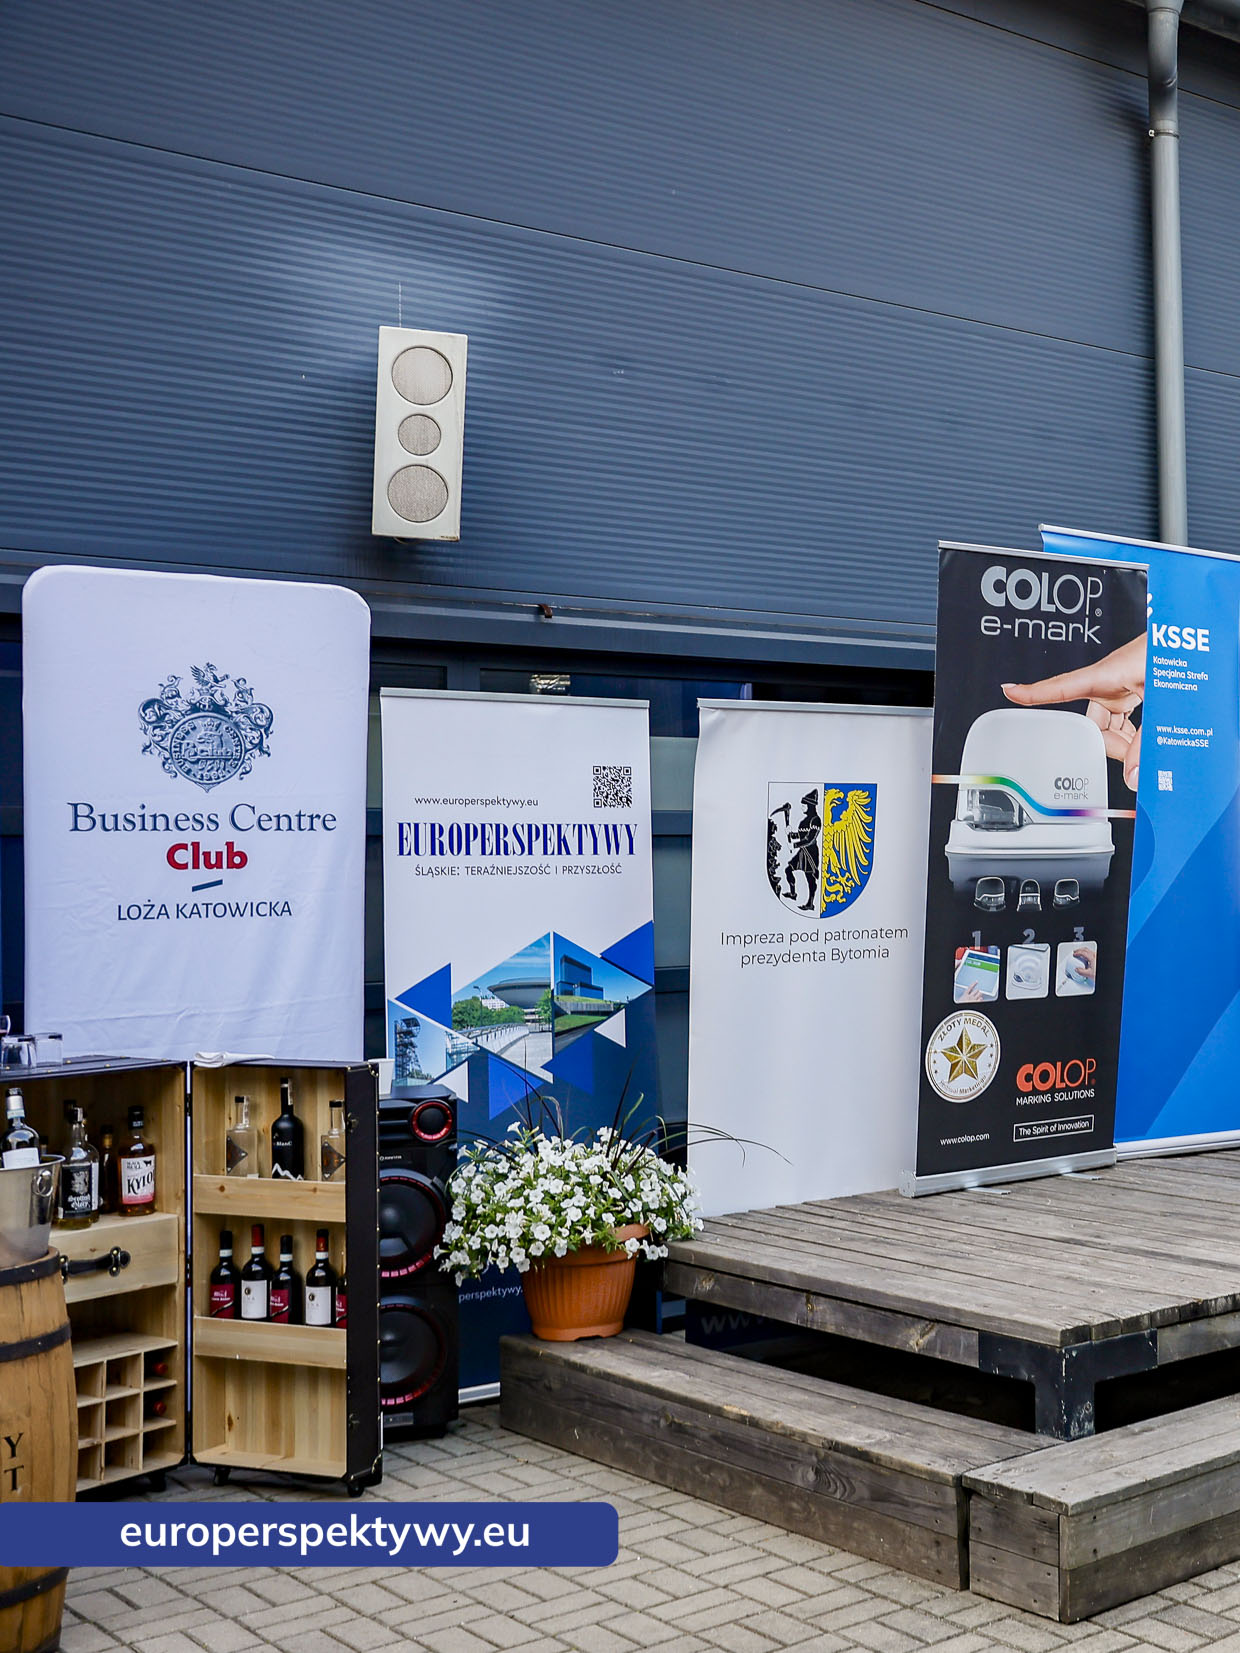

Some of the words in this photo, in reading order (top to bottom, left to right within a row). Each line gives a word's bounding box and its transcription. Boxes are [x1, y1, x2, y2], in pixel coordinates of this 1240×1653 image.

[981, 565, 1103, 615] COLOP
[981, 615, 1102, 645] e-mark
[1152, 624, 1210, 652] KSSE
[1153, 656, 1188, 668] Katowicka
[1153, 668, 1185, 681] Specjalna
[1186, 670, 1209, 680] Strefa
[1153, 679, 1198, 691] Ekonomiczna
[1156, 725, 1213, 737] www.ksse.com.pl
[1157, 736, 1209, 748] @KatowickaSSE
[1055, 777, 1089, 791] COLOP
[414, 796, 539, 808] www.europerspektywy.eu
[1054, 791, 1089, 800] e-mark
[67, 802, 220, 832] Business
[229, 803, 337, 832] Centre
[397, 822, 638, 857] EUROPERSPEKTYWY
[166, 841, 248, 871] Club
[415, 864, 461, 878] ŚLĄSKIE:
[465, 863, 551, 877] TERAŹNIEJSZOŚĆ
[562, 862, 623, 876] PRZYSZŁOŚĆ
[117, 898, 170, 921] LOŻA
[176, 901, 292, 920] KATOWICKA
[721, 932, 784, 948] Impreza
[789, 929, 820, 946] pod
[824, 927, 909, 944] patronatem
[971, 930, 983, 948] 1
[1022, 928, 1036, 944] 2
[1072, 926, 1085, 942] 3
[741, 949, 827, 968] prezydenta
[831, 945, 890, 964] Bytomia
[938, 1018, 962, 1042] ZŁOTY
[963, 1017, 992, 1038] MEDAL
[1016, 1058, 1097, 1092] COLOP
[1016, 1093, 1052, 1107] MARKING
[1054, 1088, 1095, 1103] SOLUTIONS
[1019, 1126, 1031, 1136] The
[1032, 1123, 1048, 1136] Spirit
[1049, 1122, 1057, 1132] of
[1058, 1119, 1090, 1131] Innovation
[940, 1132, 990, 1146] www.colop.com
[459, 1286, 524, 1304] perspektywy.
